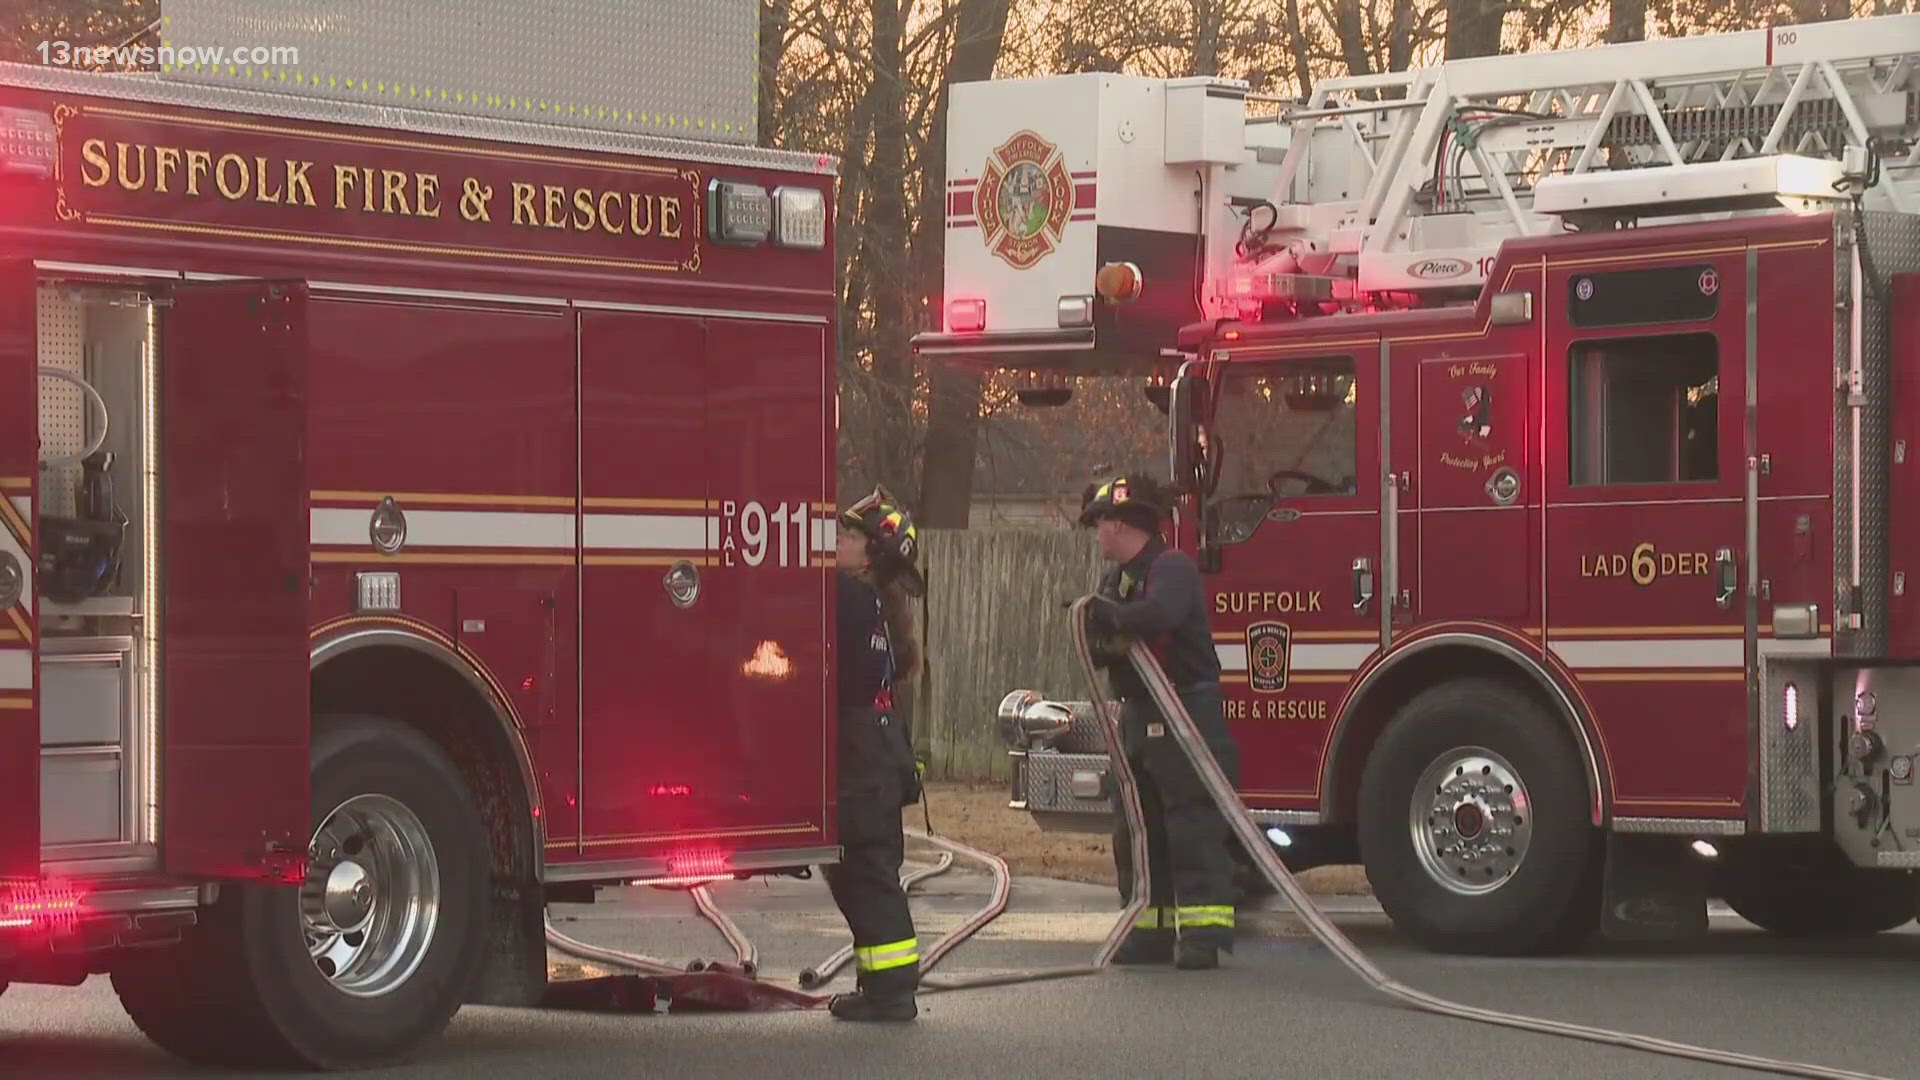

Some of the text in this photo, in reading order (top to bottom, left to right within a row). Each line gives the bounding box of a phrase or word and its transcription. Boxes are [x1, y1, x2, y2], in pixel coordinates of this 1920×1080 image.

[1776, 31, 1797, 46] 100
[1005, 140, 1044, 156] SUFFOLK
[80, 139, 683, 240] SUFFOLK FIRE & RESCUE
[1420, 262, 1458, 275] Pierce
[1469, 361, 1497, 379] Family
[723, 500, 809, 568] DIAL 911
[1215, 591, 1322, 613] SUFFOLK
[1222, 700, 1327, 719] IRE & RESCUE
